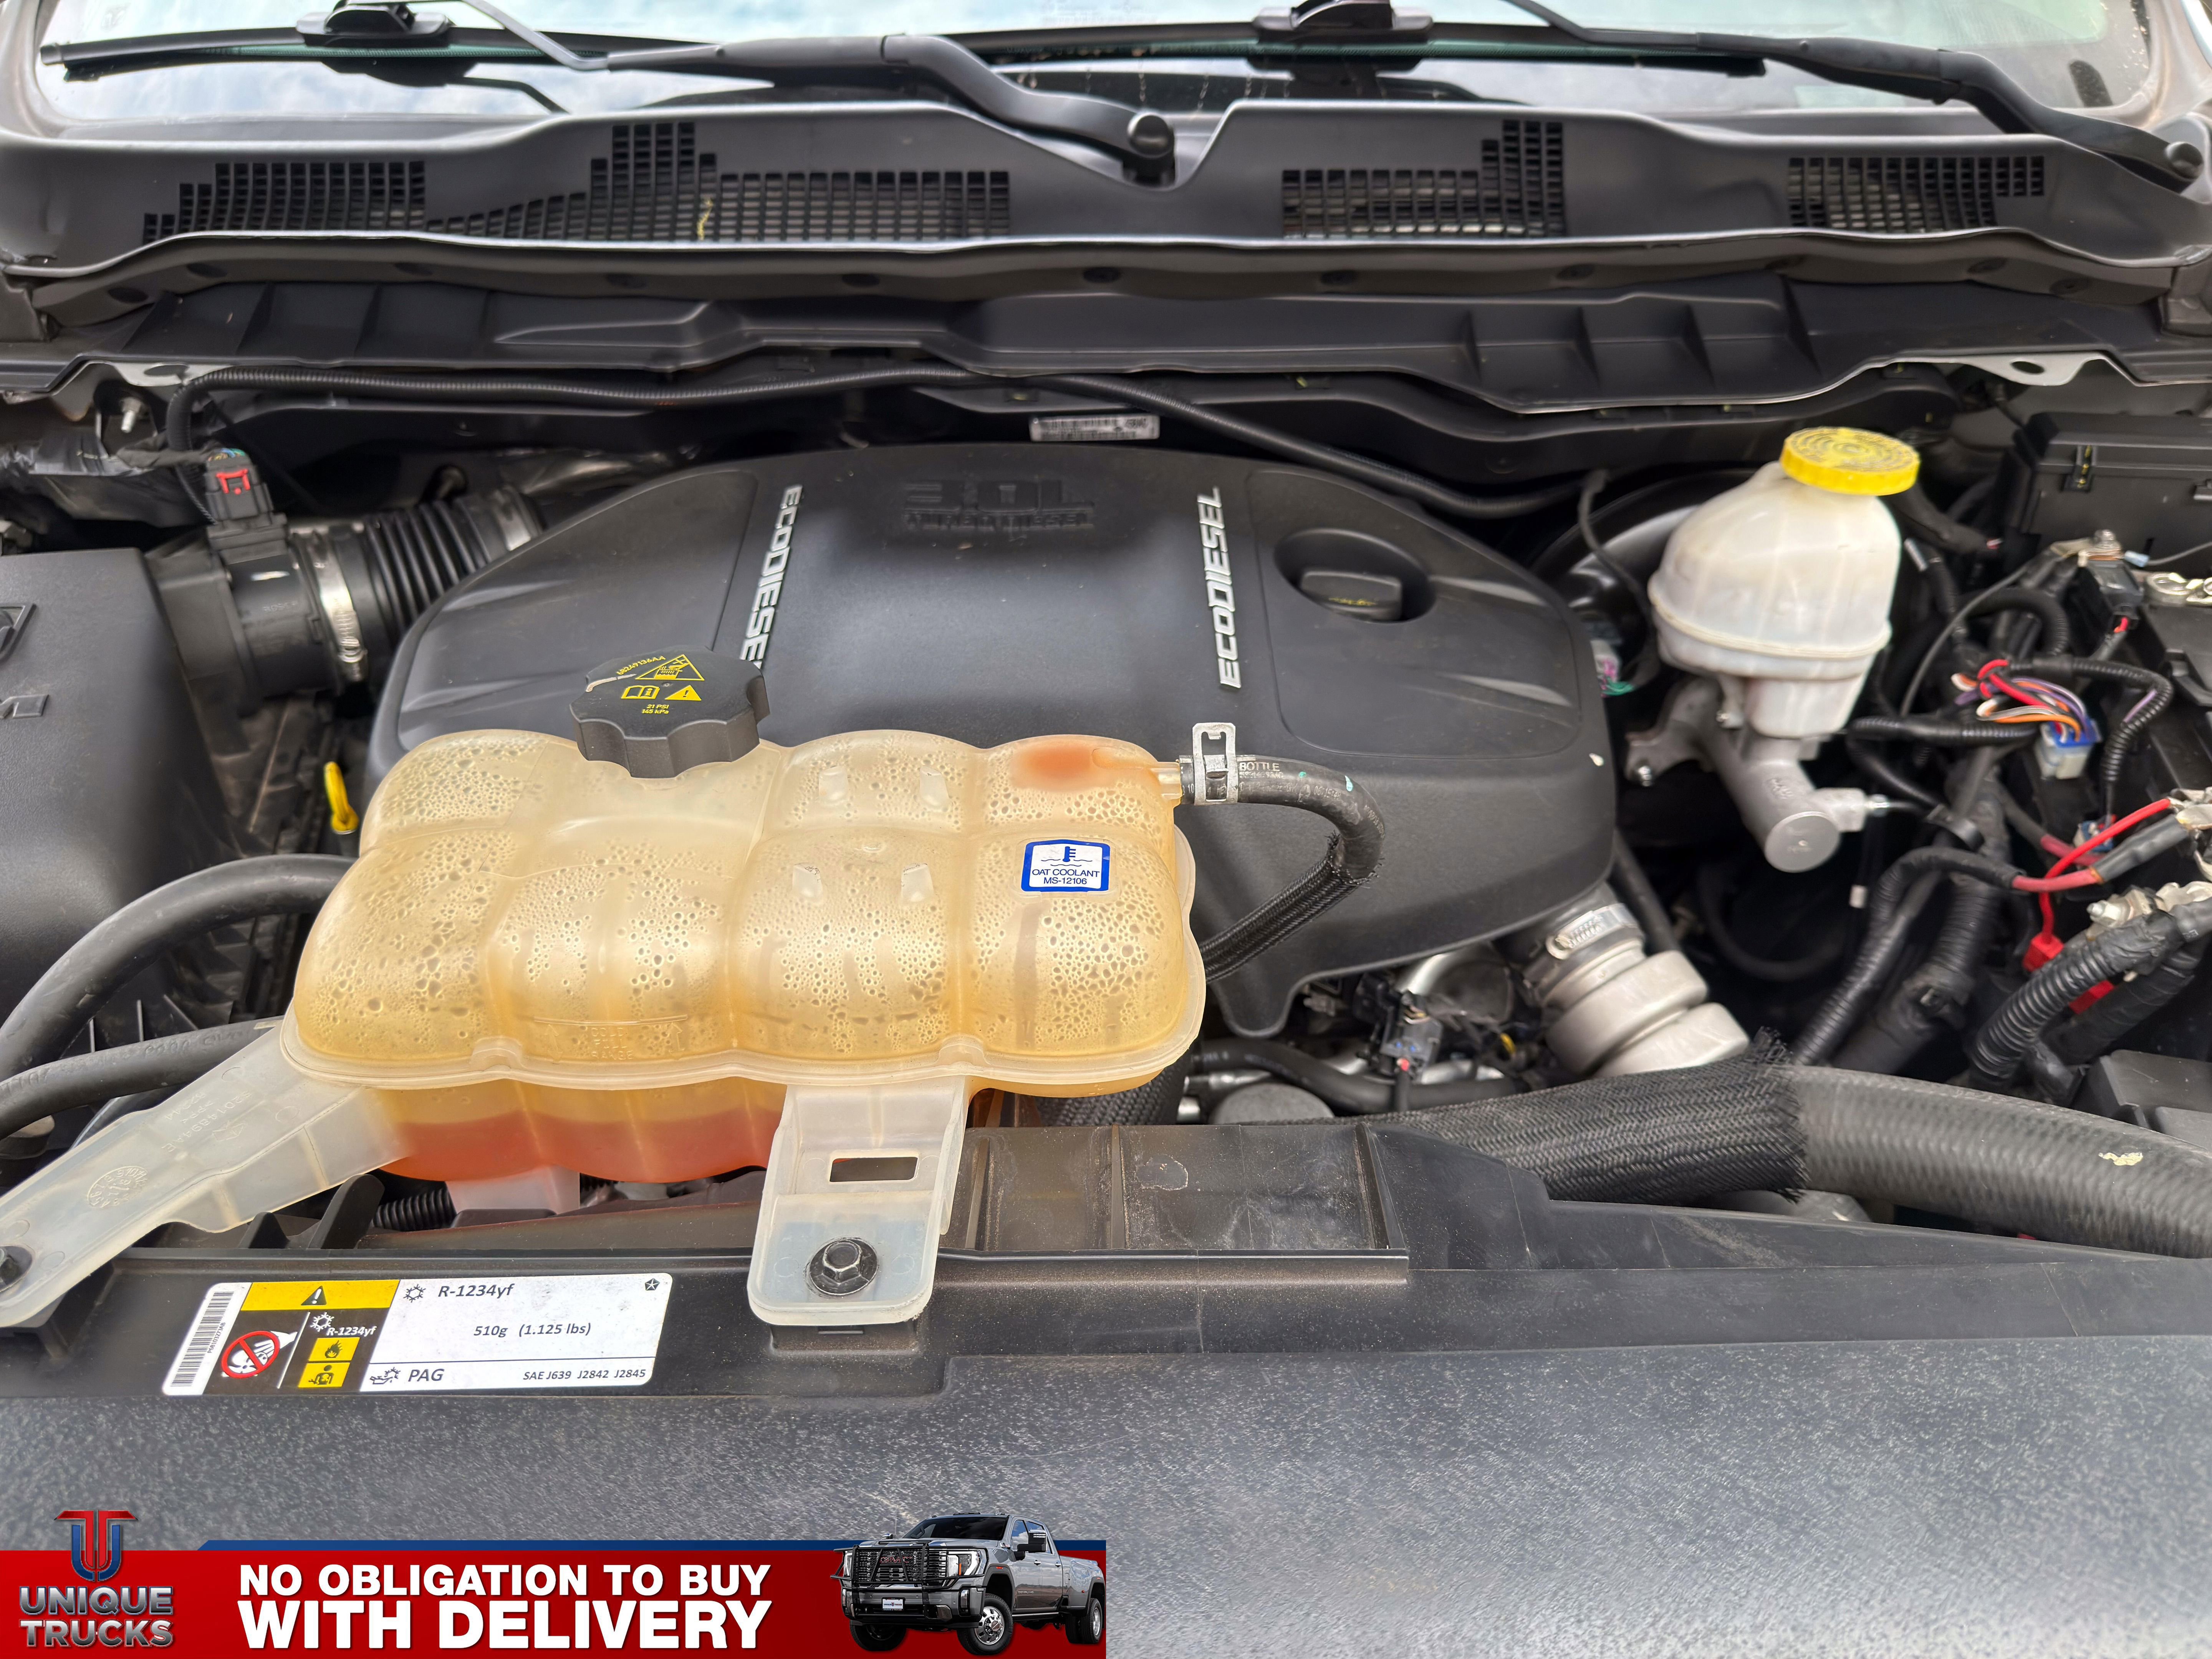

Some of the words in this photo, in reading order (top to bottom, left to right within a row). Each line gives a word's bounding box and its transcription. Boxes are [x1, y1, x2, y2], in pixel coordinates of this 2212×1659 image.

[1197, 486, 1242, 689] ECODIESEL
[617, 656, 666, 675] 68249136AA
[1053, 869, 1100, 878] COOLANT
[438, 1283, 515, 1298] R-1234yf
[207, 1322, 226, 1353] P68103273AB
[326, 1326, 377, 1337] R-1234yf
[474, 1325, 508, 1338] 510g
[519, 1324, 562, 1337] (1.125
[566, 1322, 591, 1335] lbs)
[408, 1368, 444, 1382] PAG
[523, 1371, 545, 1380] SAE
[546, 1371, 572, 1380] J639
[577, 1369, 609, 1379] J2842
[614, 1369, 646, 1379] J2845
